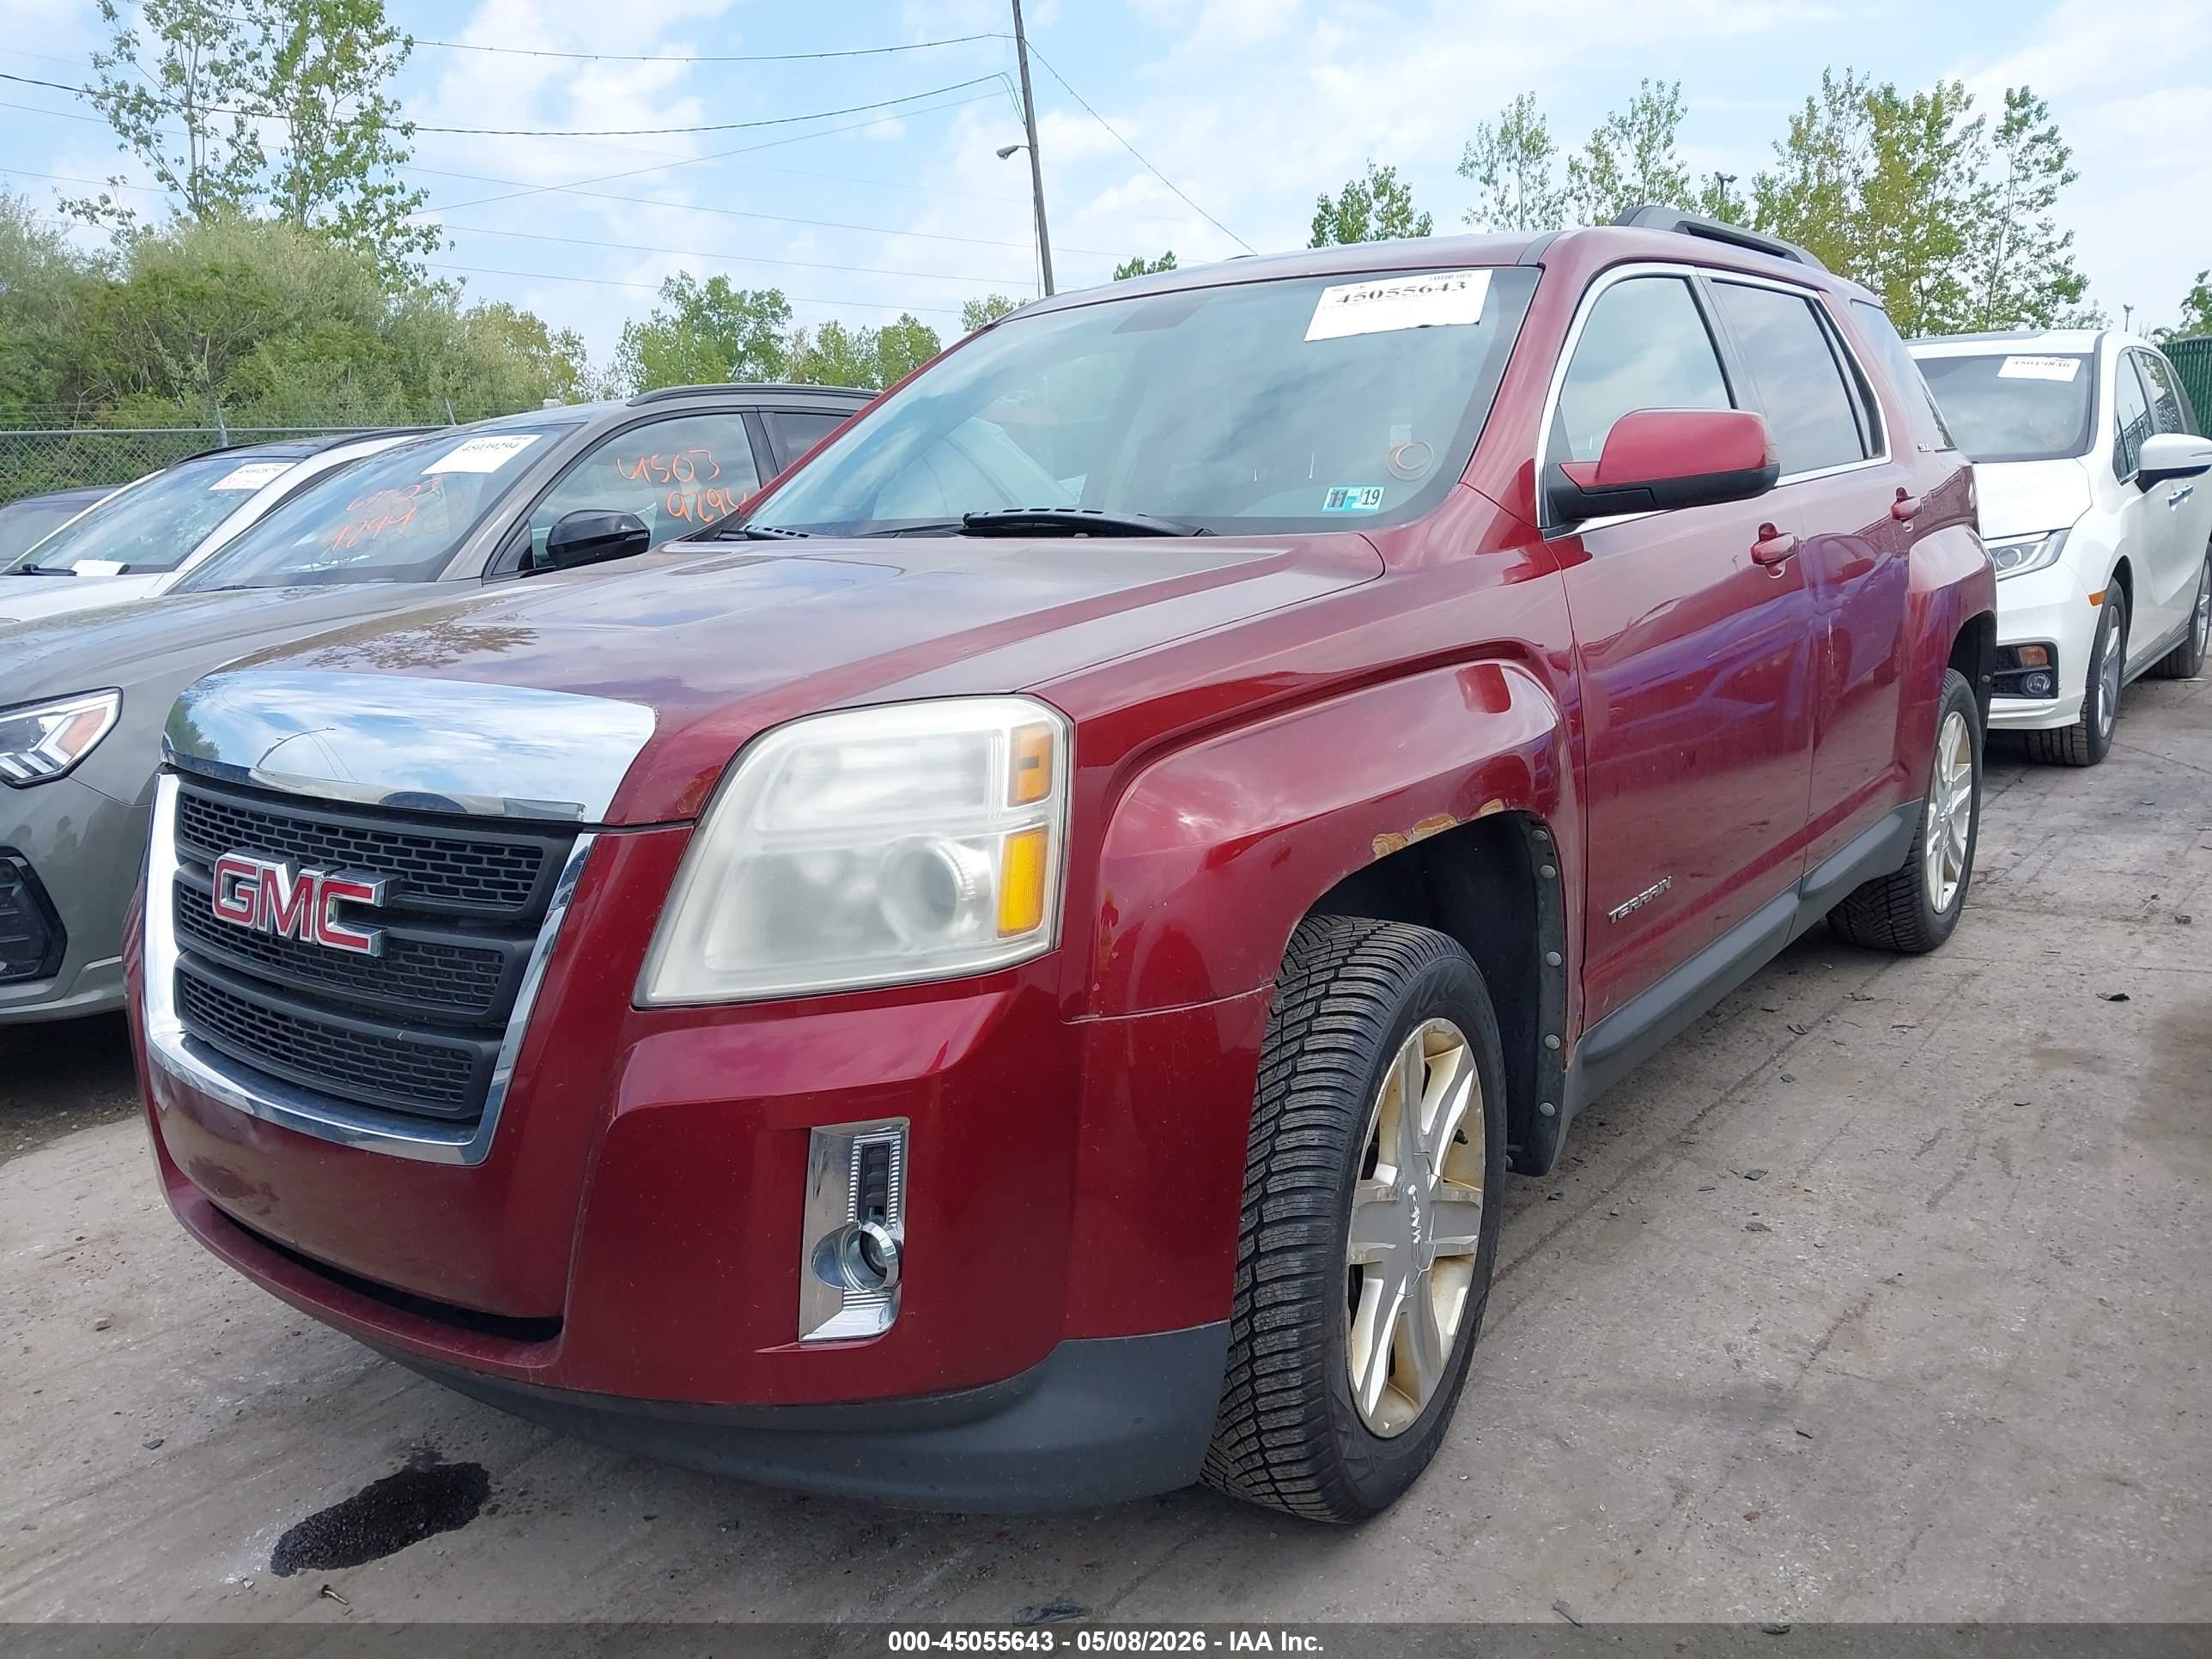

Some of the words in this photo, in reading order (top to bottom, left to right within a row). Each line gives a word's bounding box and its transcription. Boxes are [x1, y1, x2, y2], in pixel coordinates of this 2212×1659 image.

[1336, 281, 1467, 304] 45055643
[1328, 489, 1349, 508] 11
[1361, 489, 1381, 506] 19
[212, 852, 386, 957] GMC
[1607, 875, 1673, 925] TERRAIN
